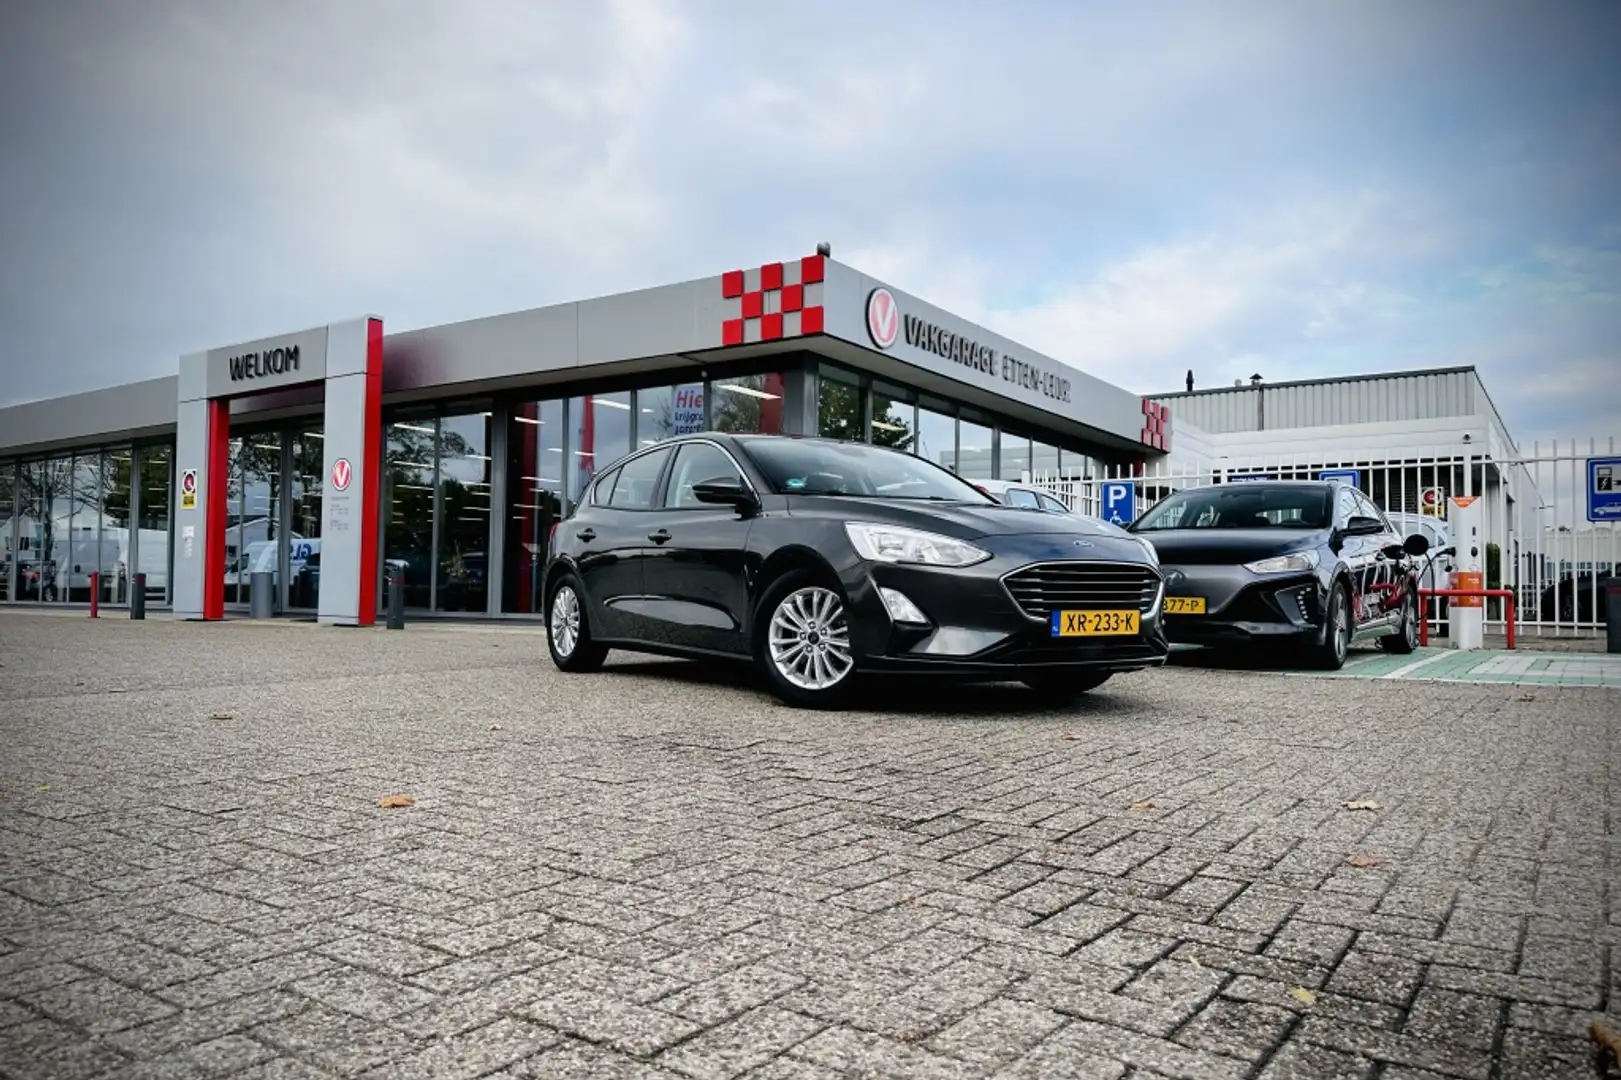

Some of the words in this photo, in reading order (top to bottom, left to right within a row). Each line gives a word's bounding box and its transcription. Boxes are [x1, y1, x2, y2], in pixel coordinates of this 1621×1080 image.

[229, 344, 300, 381] WELKOM
[904, 313, 998, 377] VAKGARAGE
[1002, 354, 1071, 404] ETTEN-LEUR
[1109, 485, 1127, 508] P
[1066, 612, 1134, 633] XR-233-K
